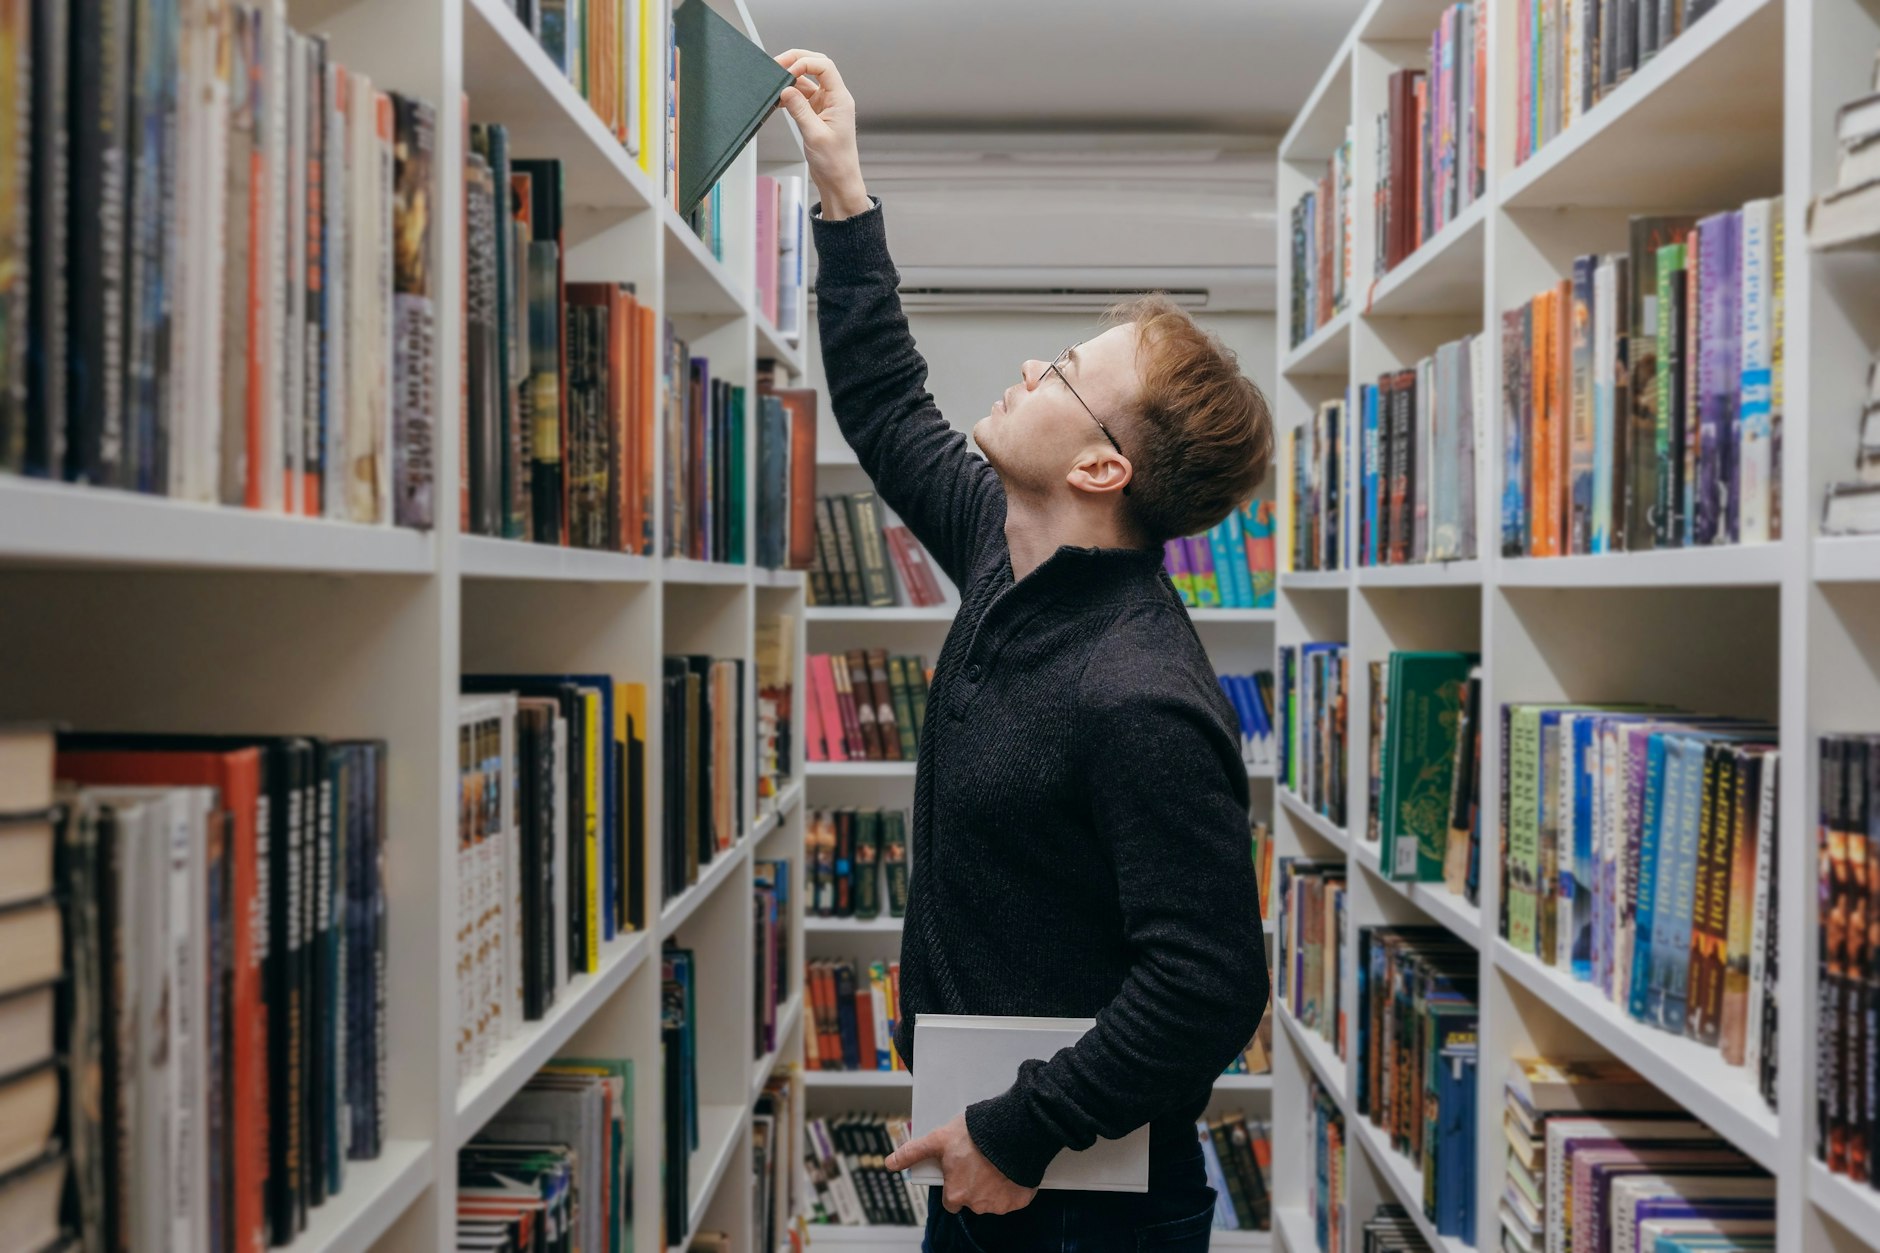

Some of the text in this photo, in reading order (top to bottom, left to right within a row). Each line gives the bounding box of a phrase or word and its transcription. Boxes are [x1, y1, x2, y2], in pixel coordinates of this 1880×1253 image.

[1657, 259, 1669, 428] НОРА РОБЕРТС
[1744, 223, 1758, 329] РОБЕРТС
[1641, 753, 1656, 911] НОРА РОБЕРТС
[1658, 757, 1678, 914] НОРА РОБЕРТС
[1677, 757, 1697, 919] НОРА РОБЕРТС
[1695, 759, 1711, 924] НОРА РОБЕРТС
[1711, 763, 1730, 930] НОРА РОБЕРТС
